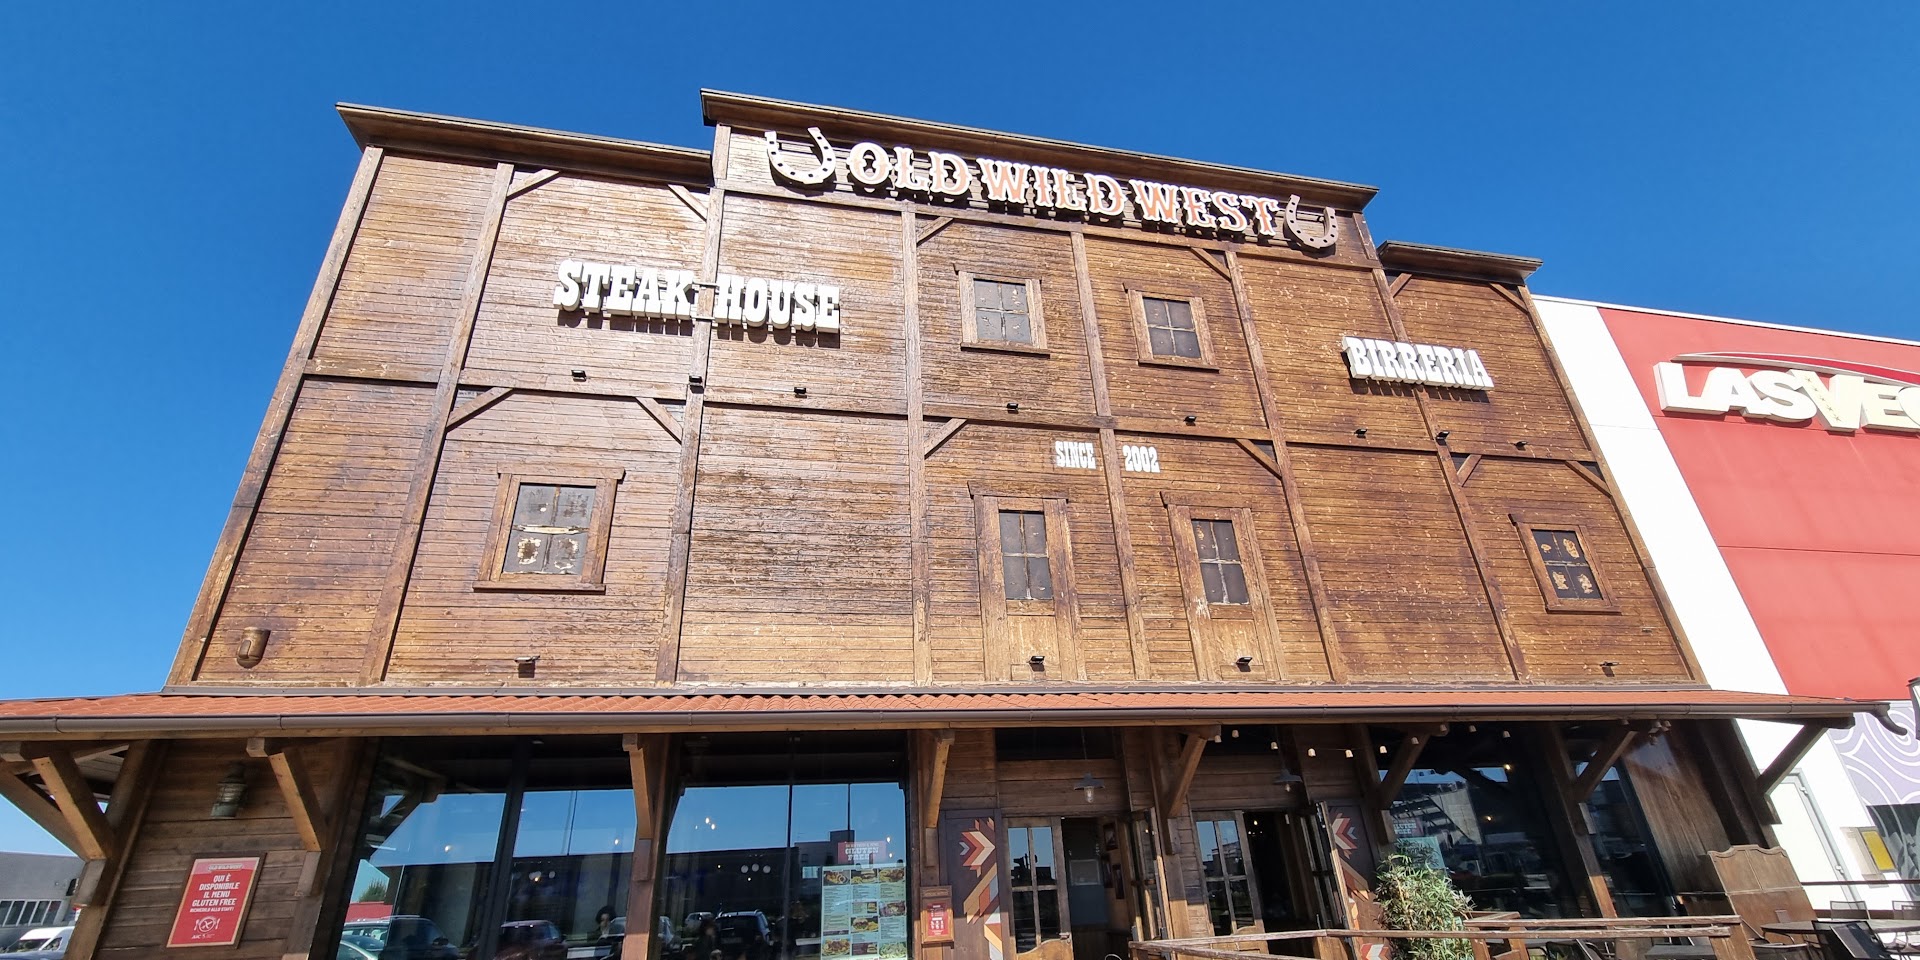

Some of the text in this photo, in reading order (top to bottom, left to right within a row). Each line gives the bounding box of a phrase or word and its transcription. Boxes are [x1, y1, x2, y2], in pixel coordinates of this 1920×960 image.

[846, 141, 1280, 237] OLD WILD WEST
[553, 260, 840, 333] STEAK HOUSE
[1342, 336, 1495, 391] BIRRERIA
[1055, 441, 1160, 473] SINCE 2002
[845, 847, 879, 855] GLUTEN
[199, 882, 240, 890] DISPONIBILE
[213, 873, 231, 883] QUI È
[192, 898, 237, 907] GLUTEN FREE
